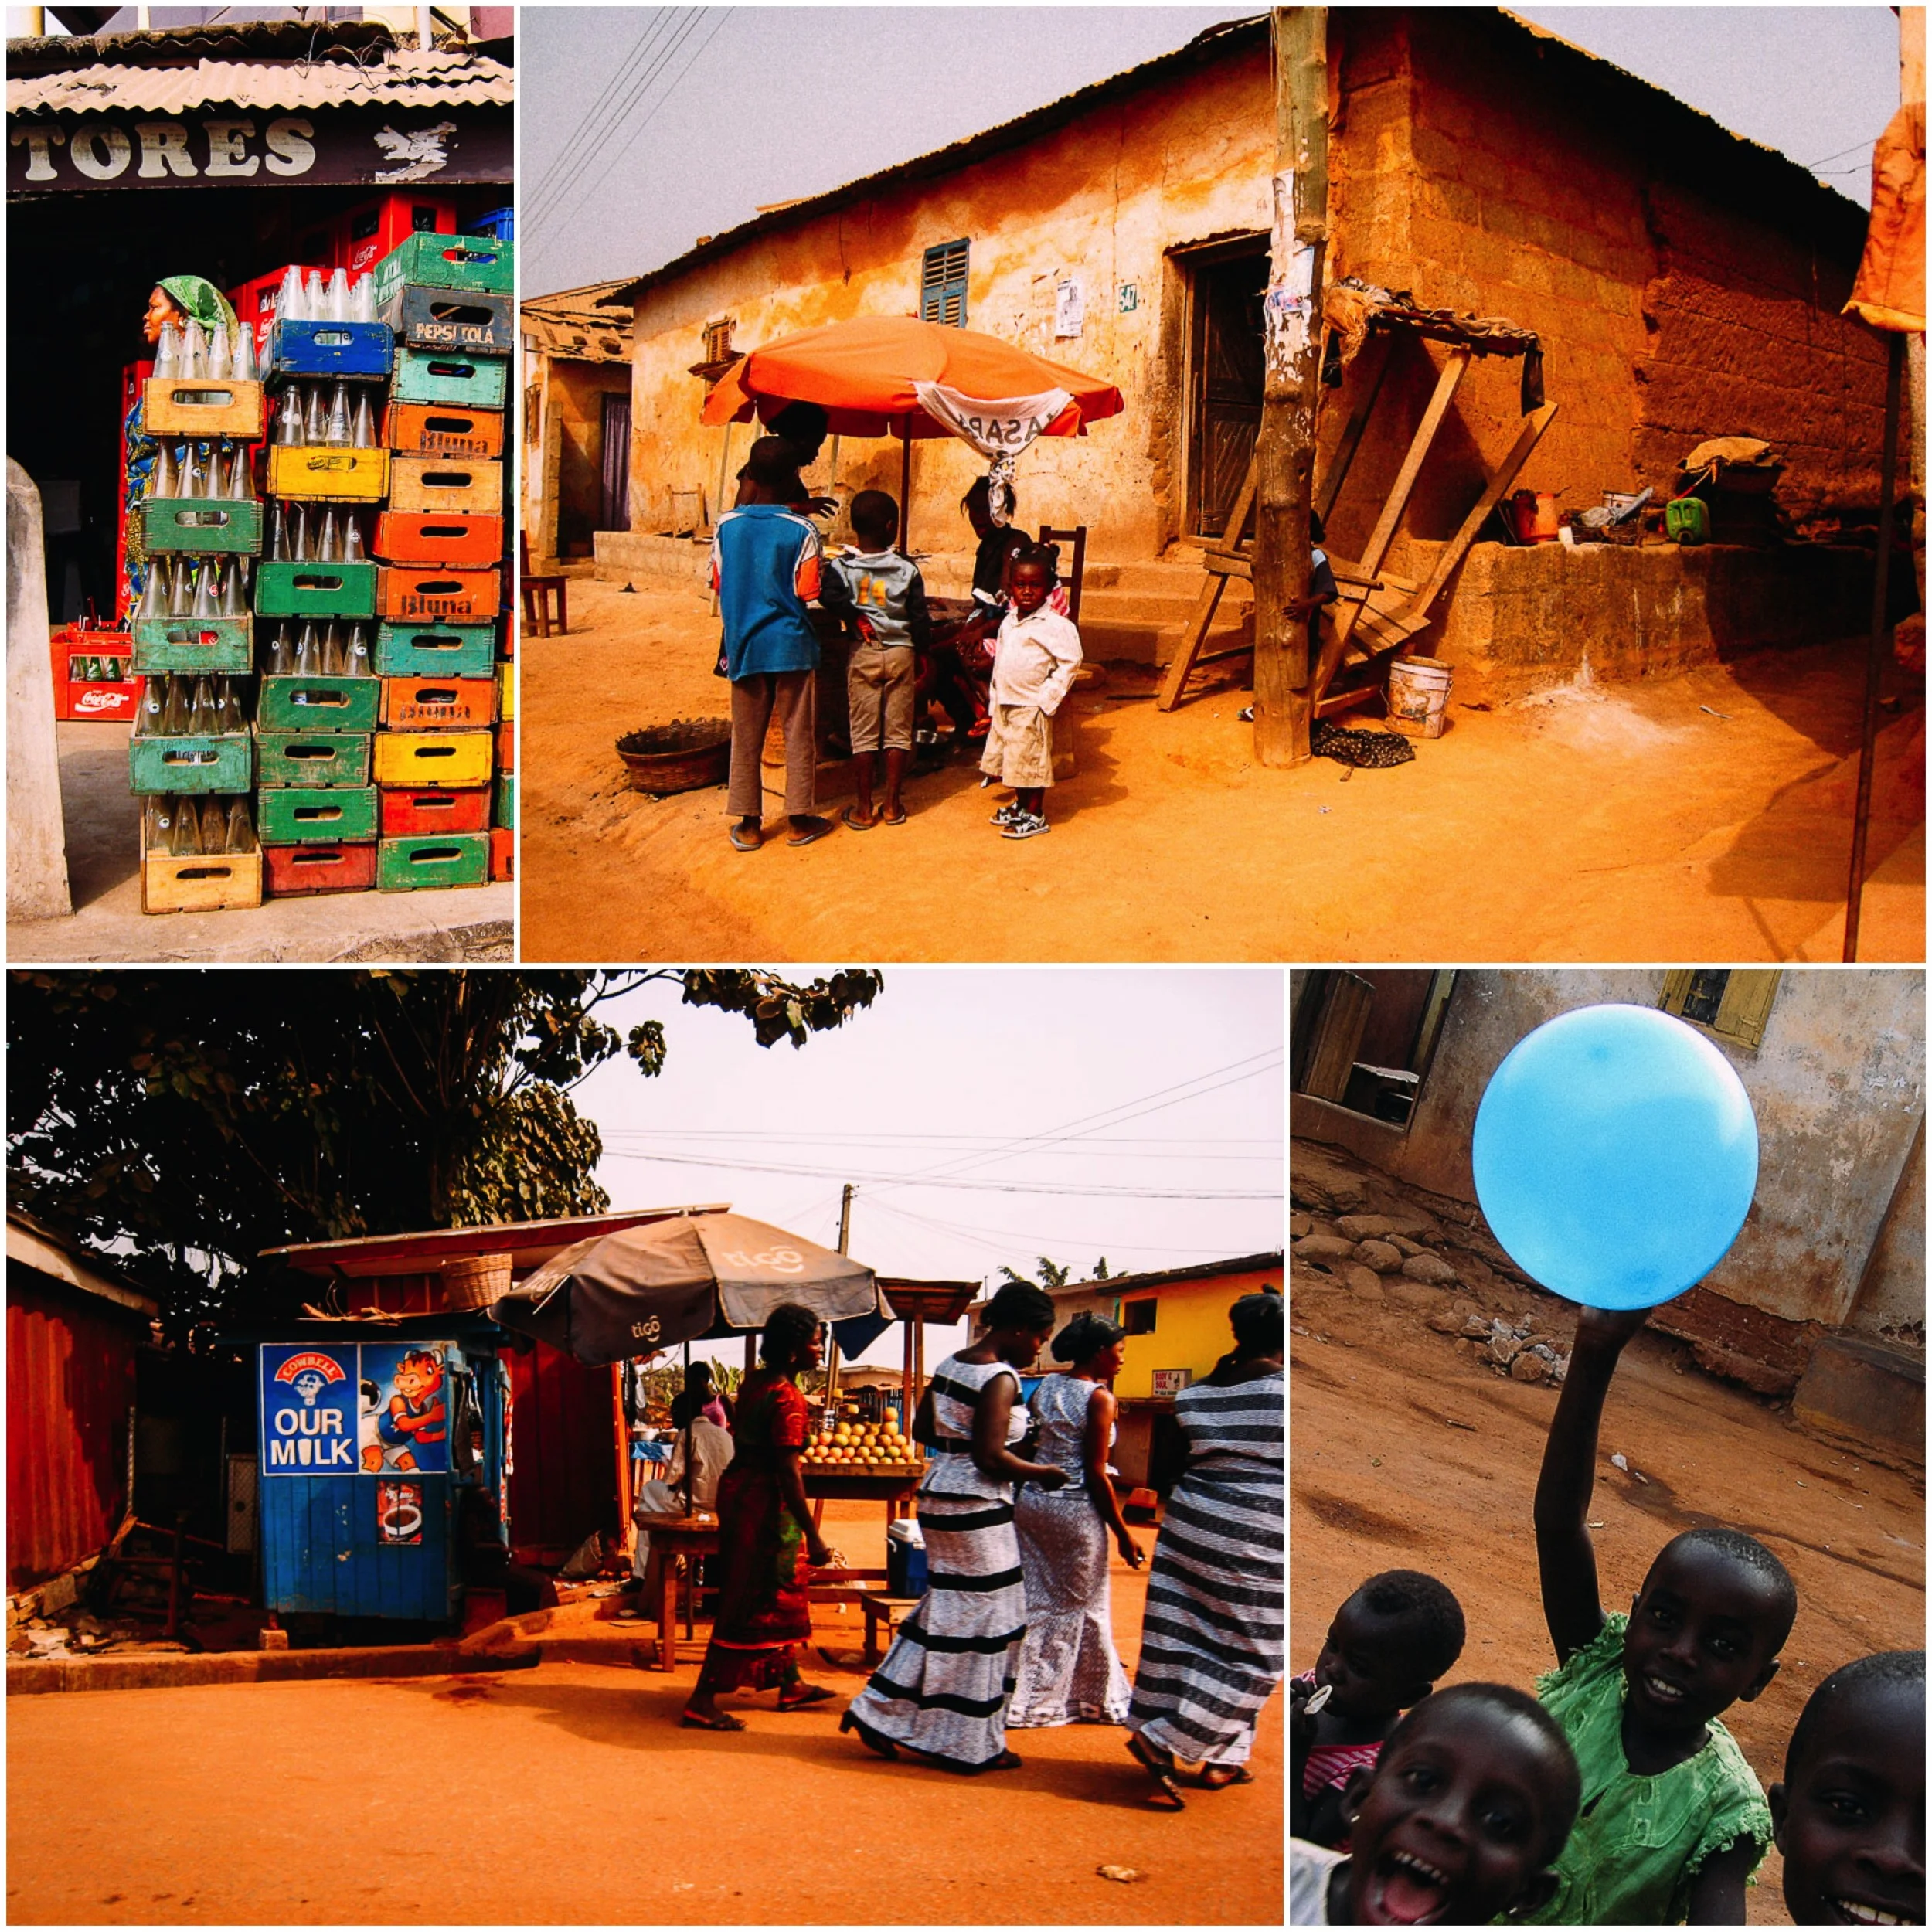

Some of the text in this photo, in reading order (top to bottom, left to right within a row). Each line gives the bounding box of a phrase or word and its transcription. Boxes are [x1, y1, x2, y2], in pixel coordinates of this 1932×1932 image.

[10, 117, 316, 181] TORES
[416, 323, 494, 344] PEPSI COLA
[420, 430, 488, 454] Bluna
[401, 595, 471, 615] Bluna
[74, 690, 130, 712] Coca-Cola
[631, 1315, 661, 1342] tigo
[283, 1356, 338, 1377] COWBELL
[274, 1408, 344, 1436] OUR
